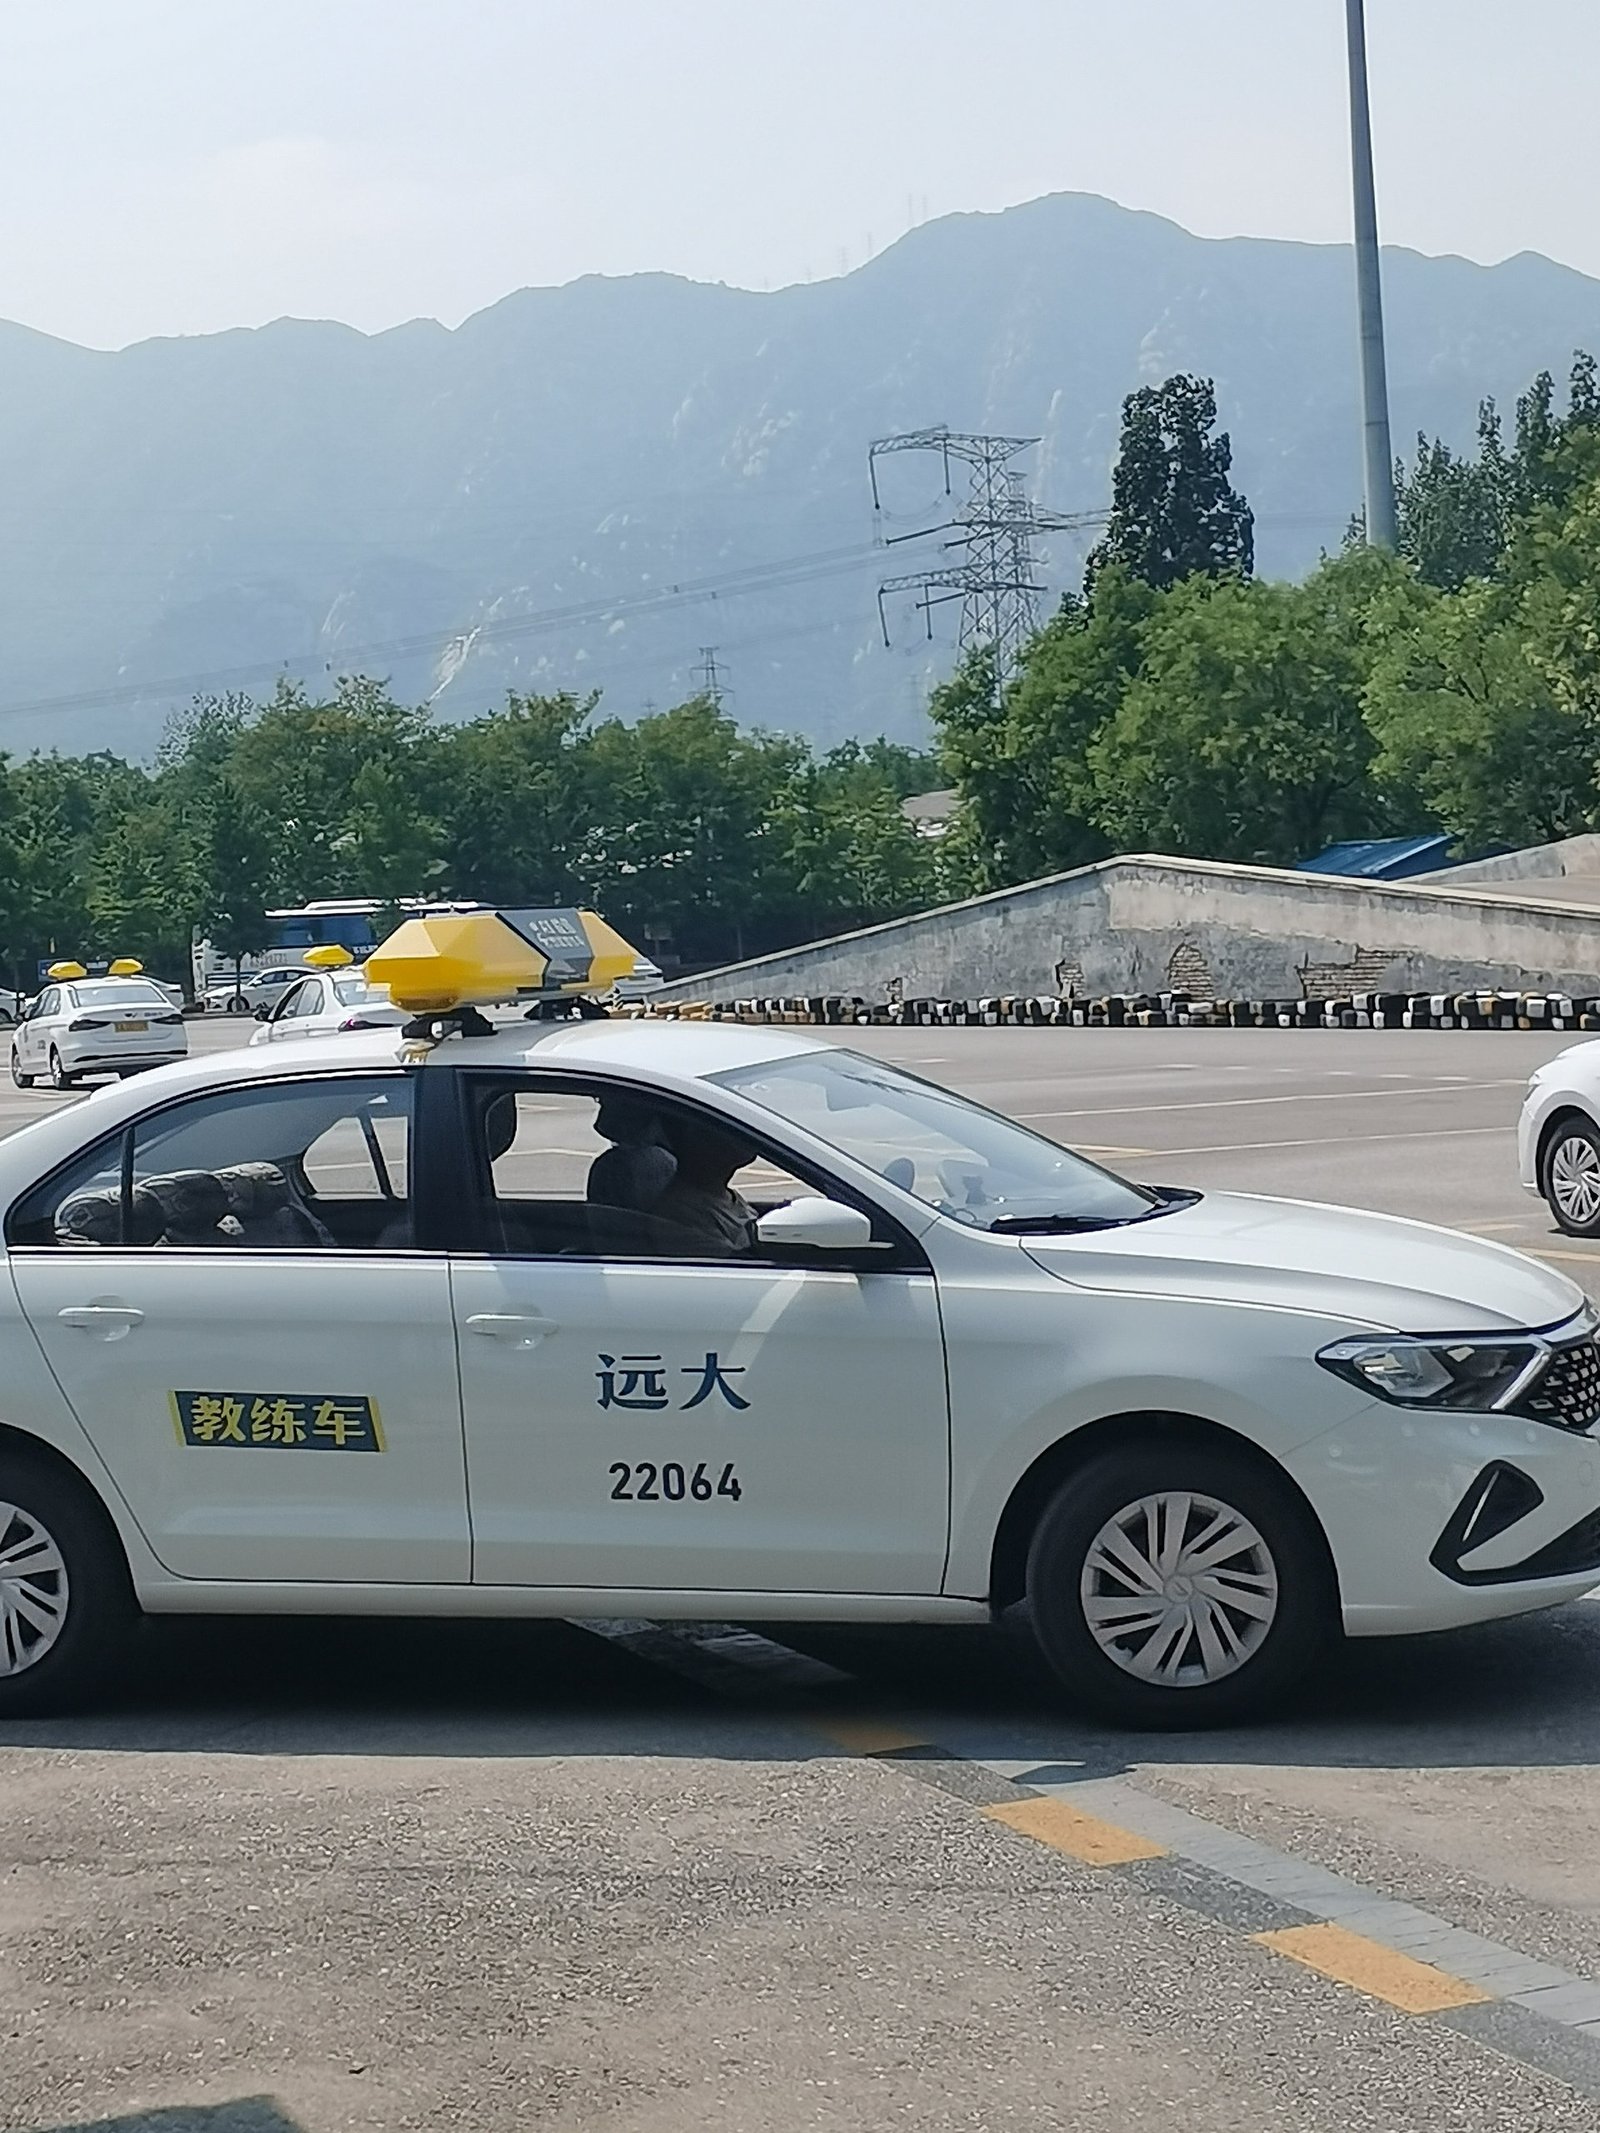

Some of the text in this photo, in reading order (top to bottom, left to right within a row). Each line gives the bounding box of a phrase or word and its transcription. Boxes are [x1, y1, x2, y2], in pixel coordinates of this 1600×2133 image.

[595, 1352, 752, 1411] 远大
[190, 1395, 367, 1446] 教练车
[608, 1462, 742, 1502] 22064
